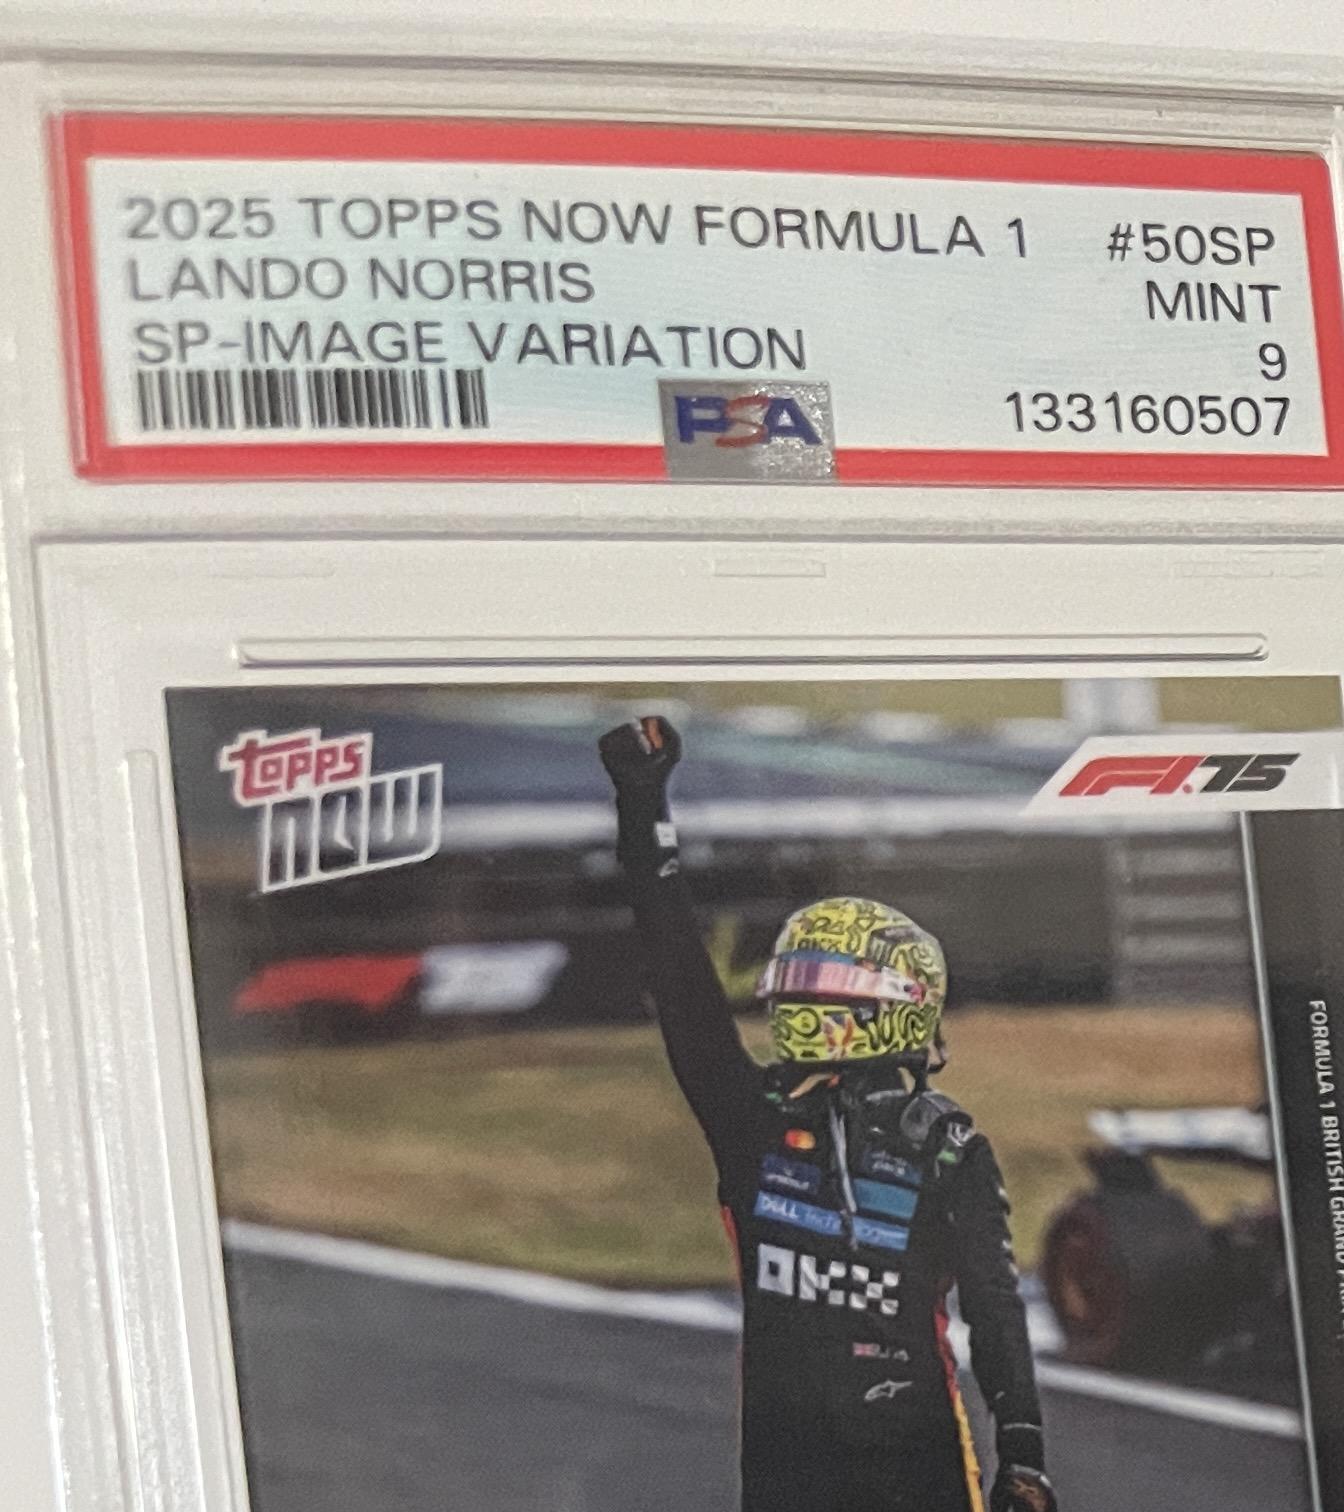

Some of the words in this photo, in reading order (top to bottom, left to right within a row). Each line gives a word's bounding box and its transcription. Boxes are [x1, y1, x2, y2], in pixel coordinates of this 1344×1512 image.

[125, 196, 276, 240] 2025
[297, 197, 503, 241] TOPPS
[523, 201, 672, 245] NOW
[697, 205, 985, 258] FORMULA
[1006, 218, 1028, 259] 1
[1107, 222, 1276, 266] #50SP
[128, 257, 347, 300] LANDO
[370, 259, 596, 303] NORRIS
[1146, 280, 1281, 324] MINT
[135, 320, 449, 365] SP-IMAGE
[467, 321, 807, 371] VARIATION
[1258, 343, 1288, 382] 9
[674, 394, 823, 448] PSA
[1005, 391, 1290, 437] 133160507
[1309, 999, 1336, 1095] FORMULA
[1319, 1101, 1337, 1109] 1
[756, 1243, 900, 1316] OKX
